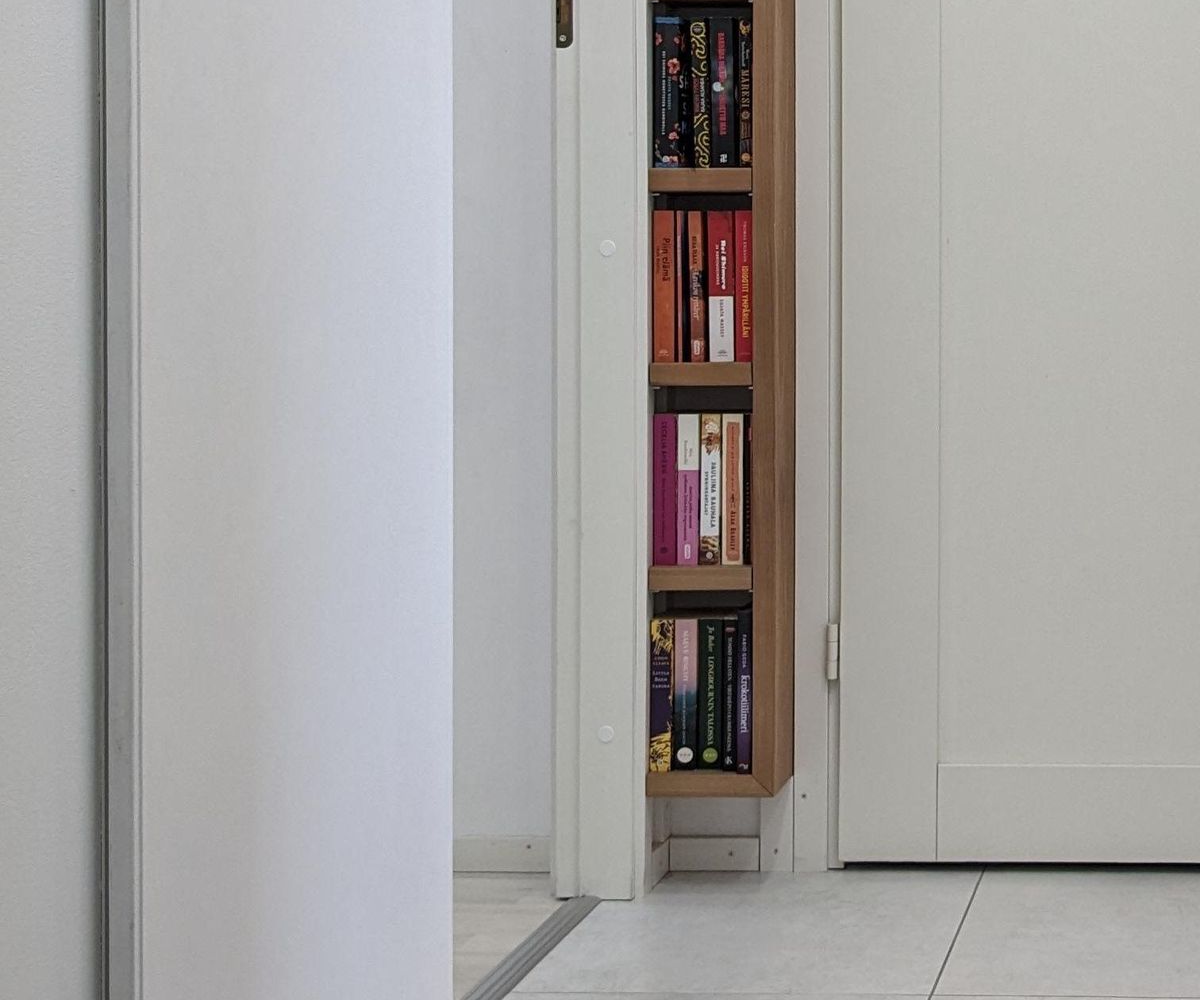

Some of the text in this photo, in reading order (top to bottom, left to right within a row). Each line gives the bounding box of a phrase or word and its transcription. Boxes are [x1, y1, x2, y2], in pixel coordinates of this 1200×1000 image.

[742, 70, 750, 107] MARESI
[662, 237, 671, 281] Piin elämä
[742, 294, 750, 337] YMPÄRILLÄNI
[707, 626, 714, 634] Jo
[740, 675, 750, 733] krokotiilimeri
